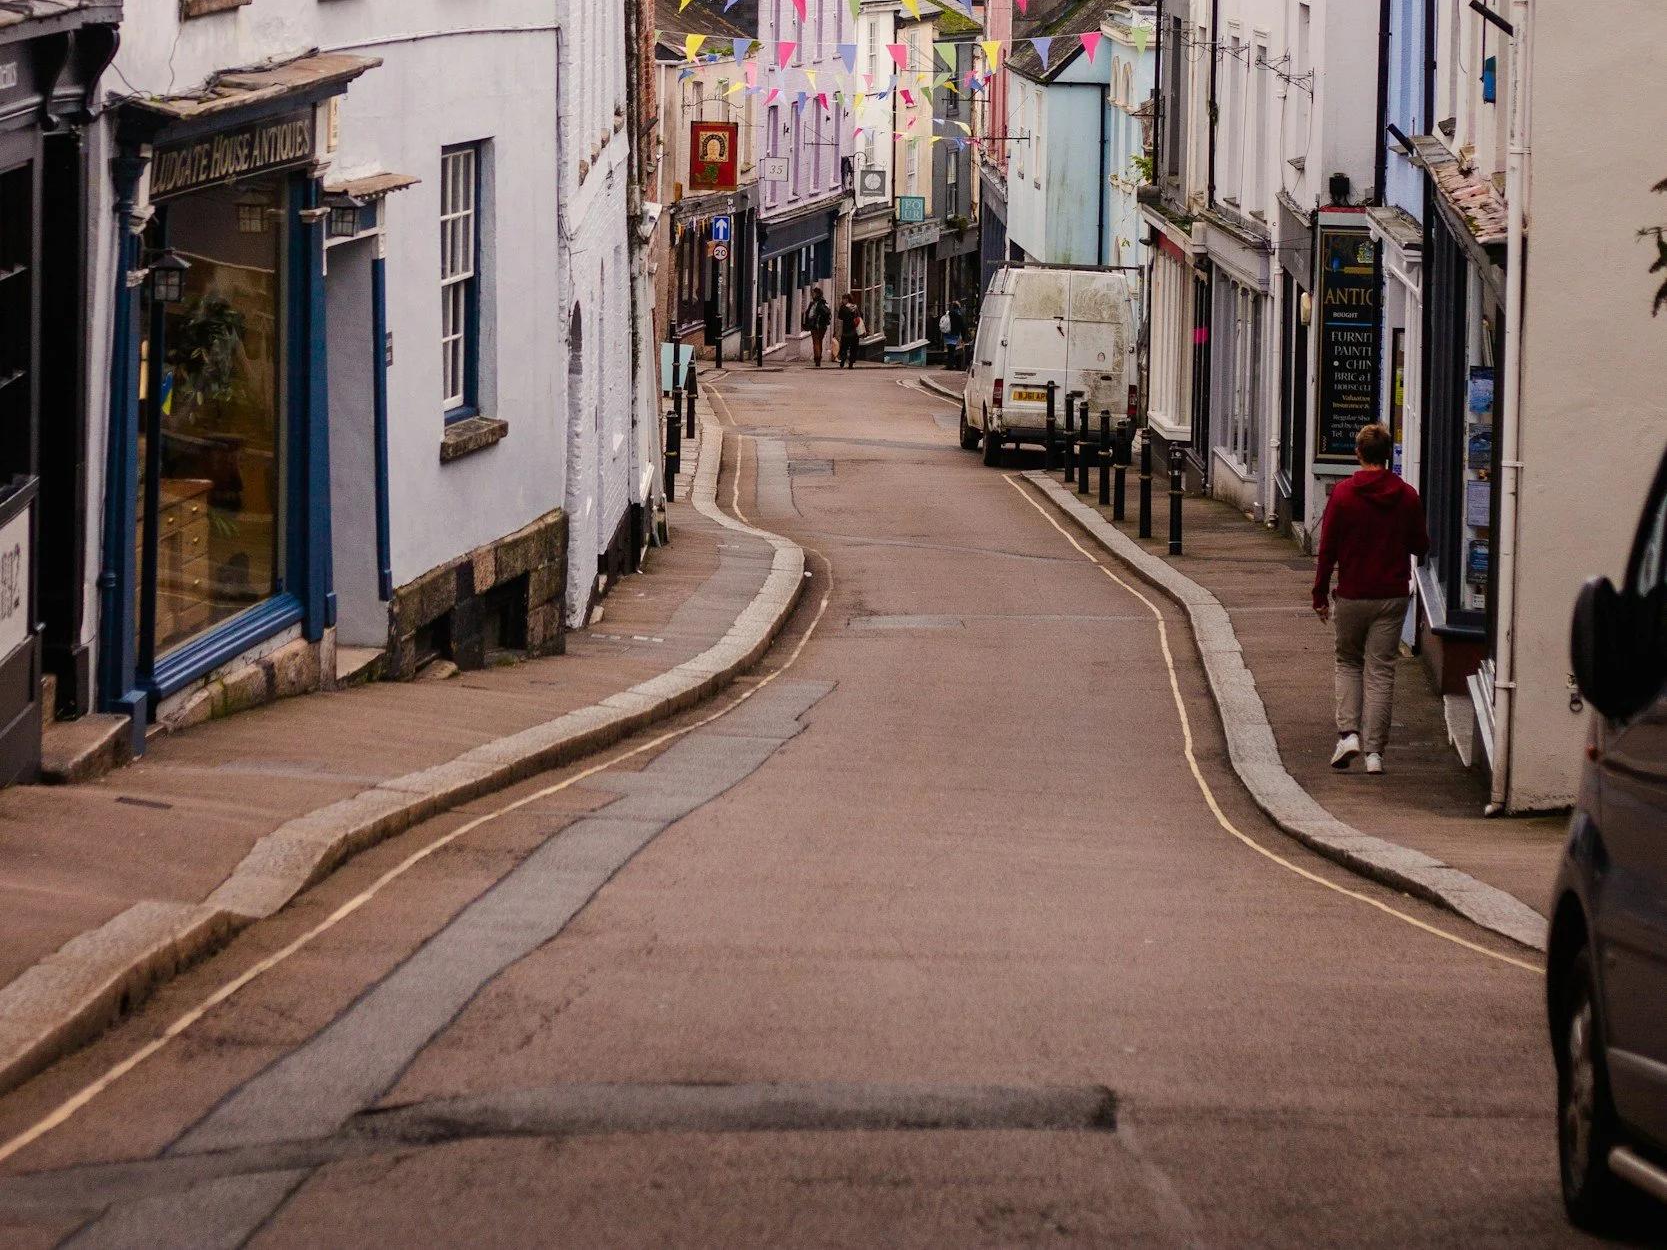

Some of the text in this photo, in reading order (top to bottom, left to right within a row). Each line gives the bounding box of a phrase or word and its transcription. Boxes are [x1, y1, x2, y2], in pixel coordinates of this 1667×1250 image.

[150, 143, 210, 193] LUDGATE
[209, 134, 252, 179] HOUSE
[250, 119, 311, 168] ANTIQUES
[769, 164, 784, 175] 35
[904, 200, 921, 209] FO
[904, 210, 920, 219] UR
[715, 249, 727, 257] 20
[1334, 371, 1358, 382] BRIC
[1036, 392, 1048, 400] AR
